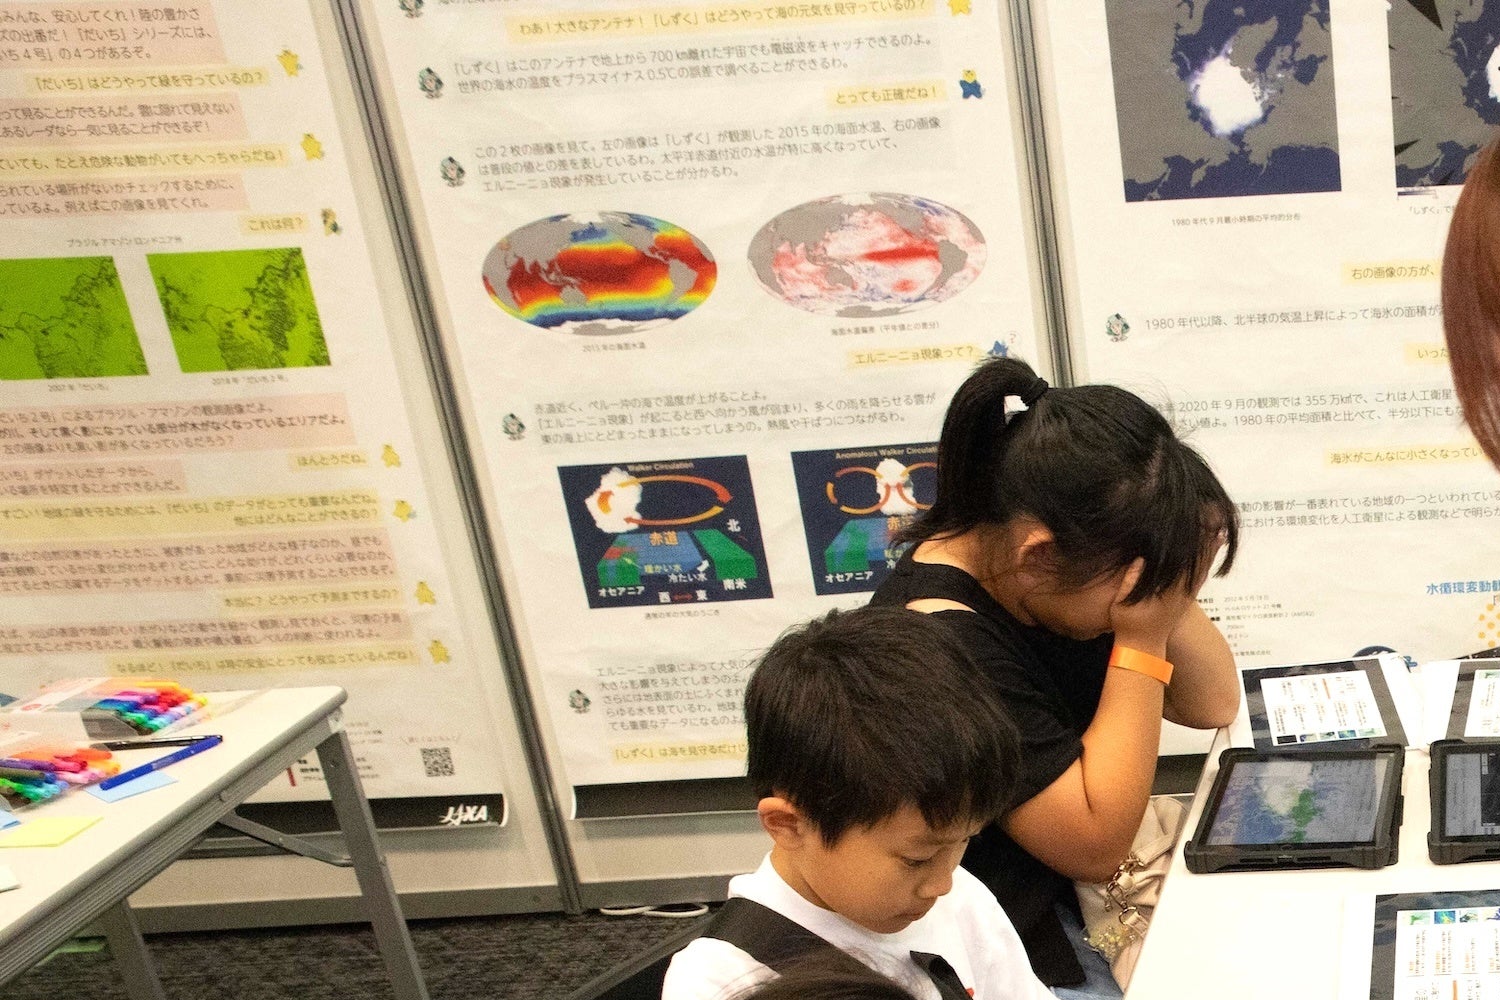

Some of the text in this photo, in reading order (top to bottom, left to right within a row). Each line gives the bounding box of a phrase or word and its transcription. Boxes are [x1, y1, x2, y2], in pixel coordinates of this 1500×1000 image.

[726, 519, 741, 532] 北
[650, 530, 679, 546] 赤道
[825, 570, 873, 583] オセアニア
[598, 586, 645, 597] オセアニア
[439, 804, 487, 825] JAXA
